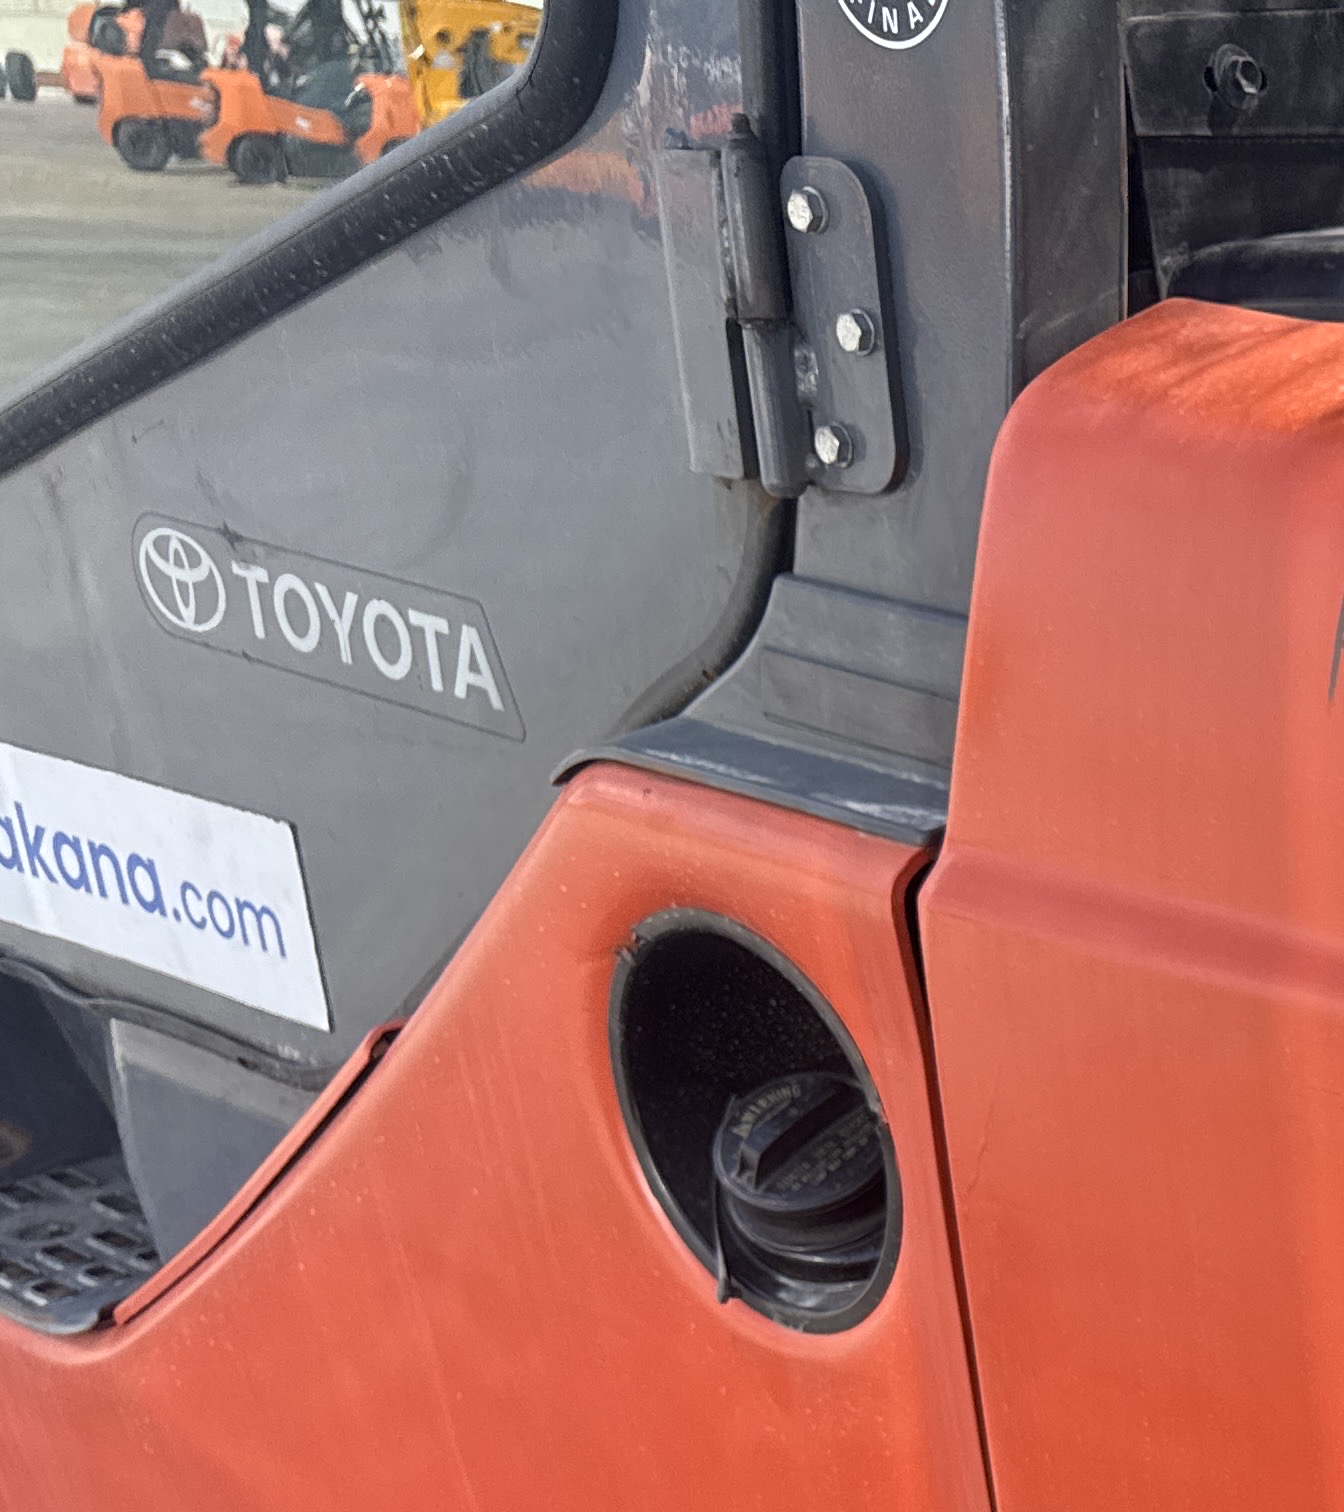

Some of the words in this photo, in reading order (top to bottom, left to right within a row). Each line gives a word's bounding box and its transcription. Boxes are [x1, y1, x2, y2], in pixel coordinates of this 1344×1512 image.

[849, 0, 924, 34] INA
[232, 561, 505, 711] TOYOTA
[0, 801, 287, 958] akana.com
